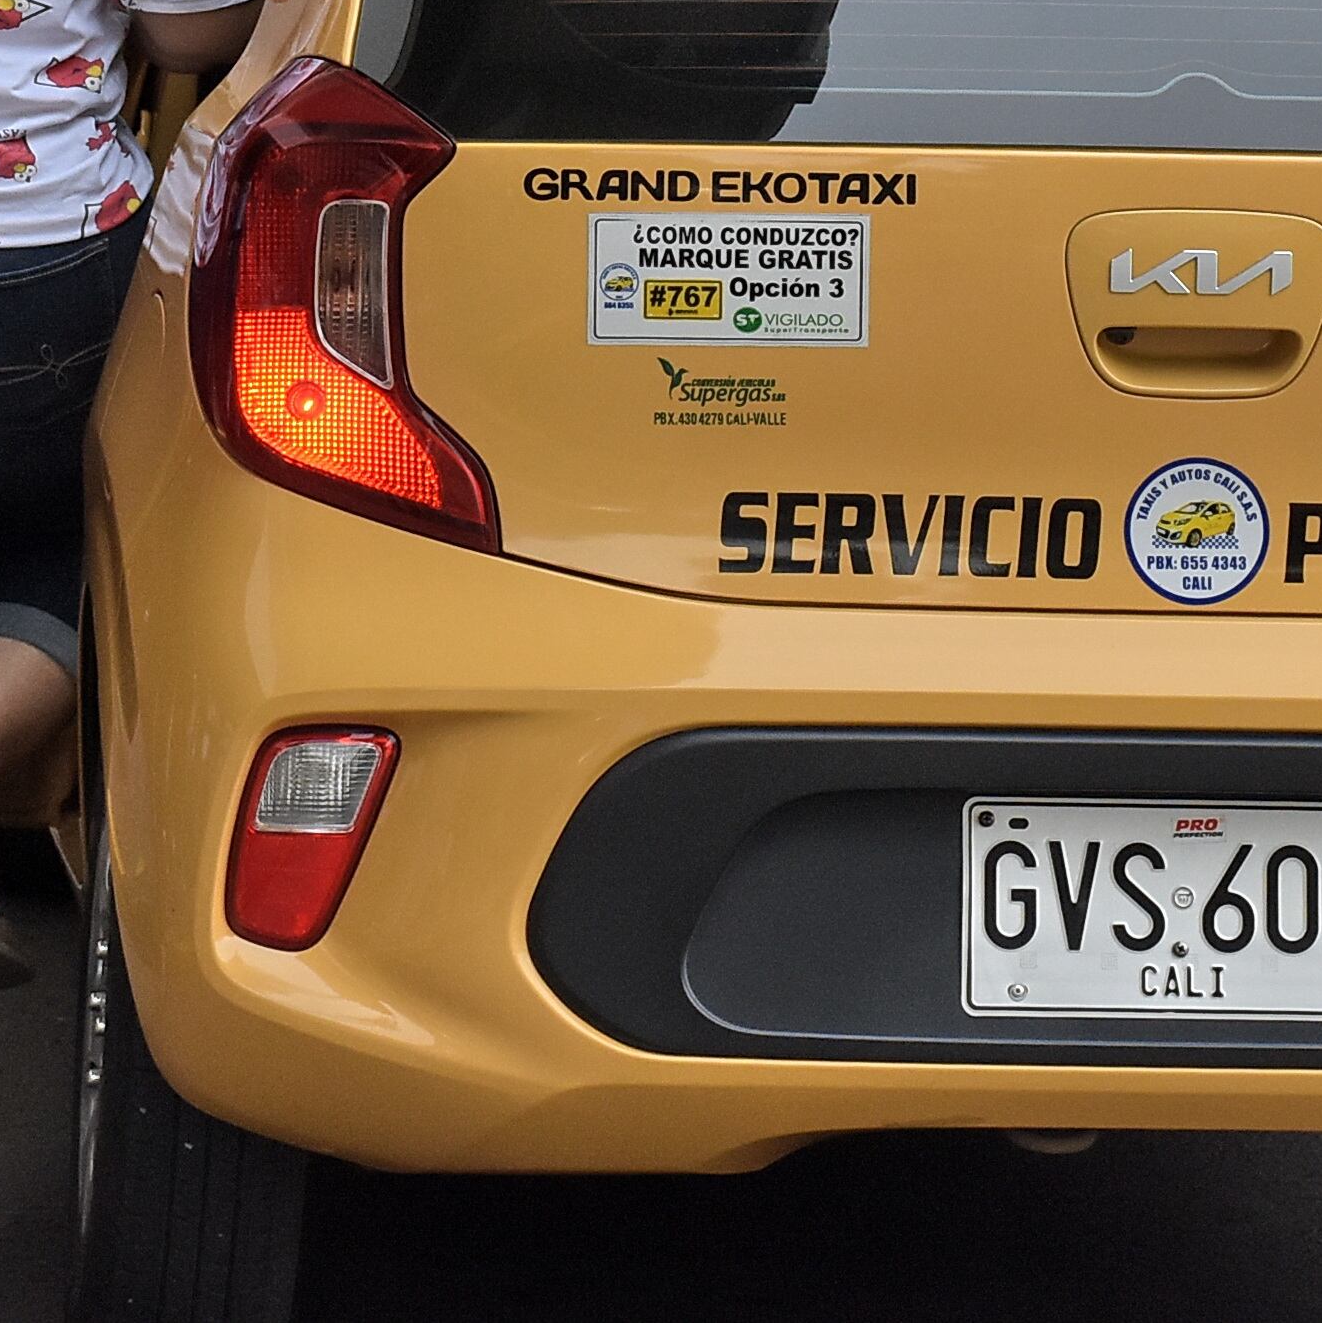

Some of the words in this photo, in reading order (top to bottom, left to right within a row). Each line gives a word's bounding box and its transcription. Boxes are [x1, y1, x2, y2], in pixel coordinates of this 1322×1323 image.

[523, 167, 700, 202] GRAND
[711, 171, 917, 205] EKOTAXI
[720, 227, 859, 246] CONDUZCO?
[638, 248, 749, 270] MARQUE
[758, 250, 853, 269] GRATIS
[649, 285, 718, 307] #767
[729, 277, 820, 302] Opción
[829, 279, 844, 298] 3
[764, 313, 844, 327] VIGILADO
[678, 382, 772, 407] Supergas
[1136, 486, 1162, 521] TAXIS
[1159, 478, 1169, 490] Y
[1169, 468, 1211, 486] AUTOS
[1213, 472, 1241, 494] CALI
[718, 491, 1101, 579] SERVICIO
[1147, 555, 1178, 570] PBX:
[1180, 556, 1208, 570] 655
[1211, 556, 1247, 571] 4343
[1182, 576, 1212, 591] CALI
[1175, 818, 1219, 832] PRO
[984, 840, 1167, 952] GVS
[1141, 966, 1225, 999] CALI
